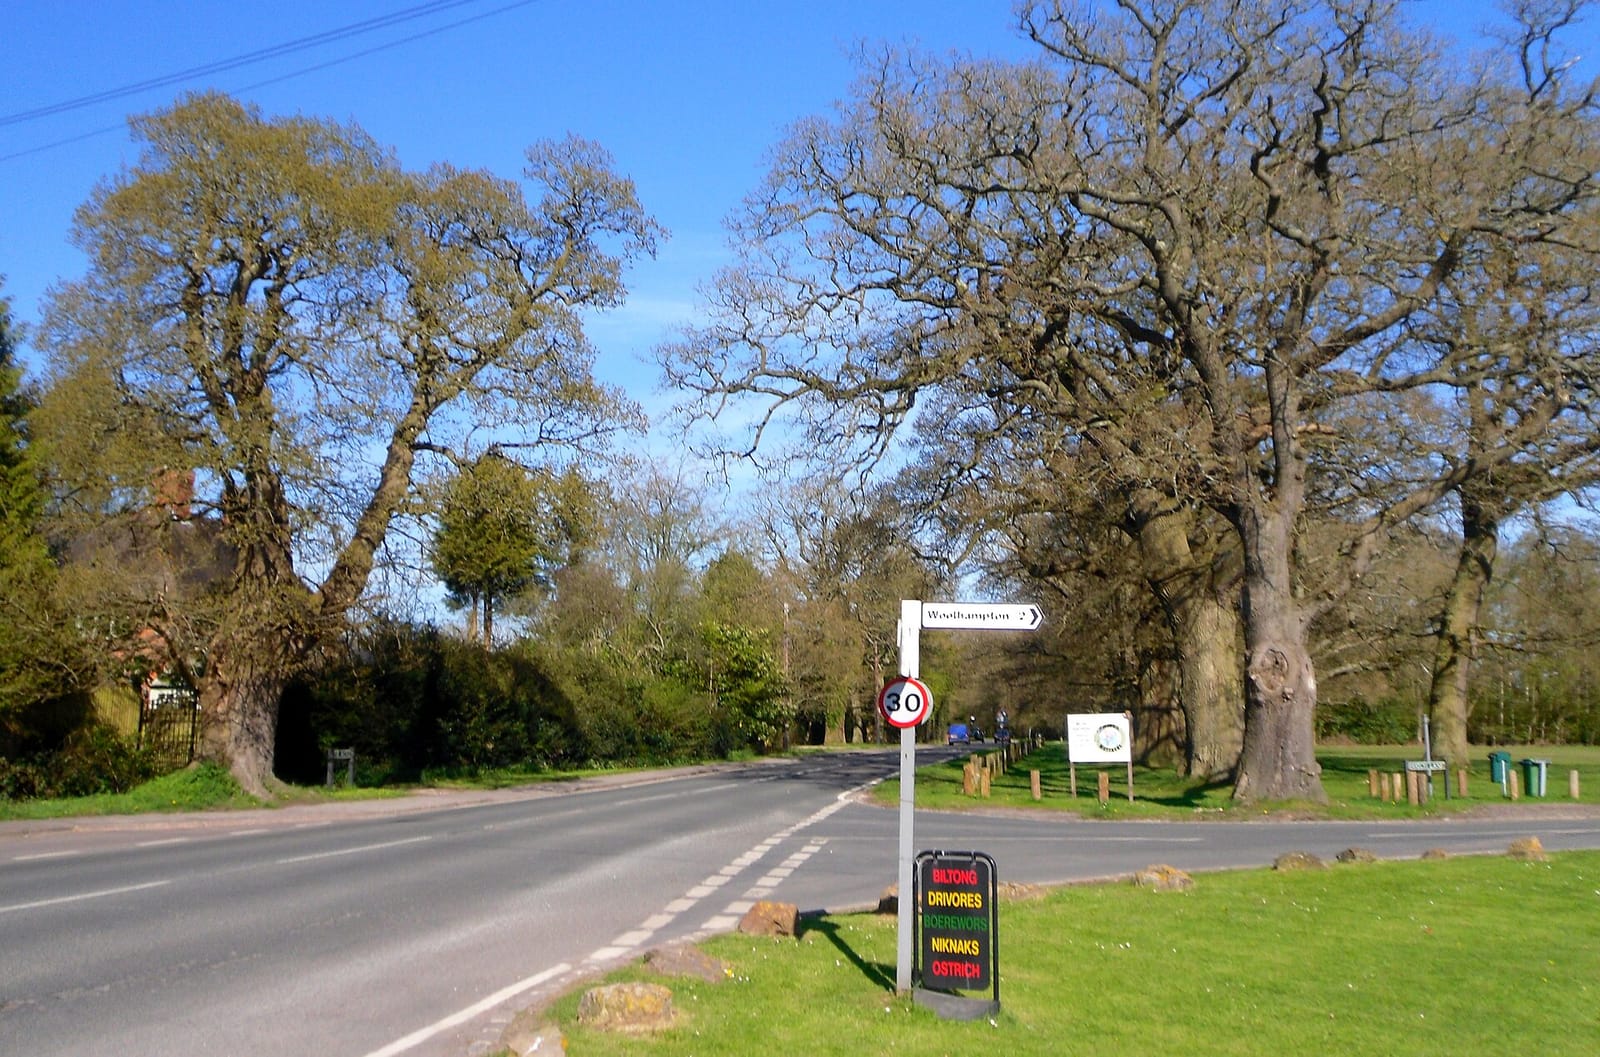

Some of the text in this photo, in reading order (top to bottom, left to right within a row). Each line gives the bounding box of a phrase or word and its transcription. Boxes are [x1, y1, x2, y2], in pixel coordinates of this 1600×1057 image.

[928, 610, 1009, 621] Woolhampton
[886, 693, 920, 712] 30
[933, 869, 977, 884] BILTONG
[928, 891, 982, 908] DRIVORES
[924, 914, 987, 930] BOEREWORS
[932, 937, 980, 955] NIKNAKS
[932, 961, 980, 977] OSTRICH
